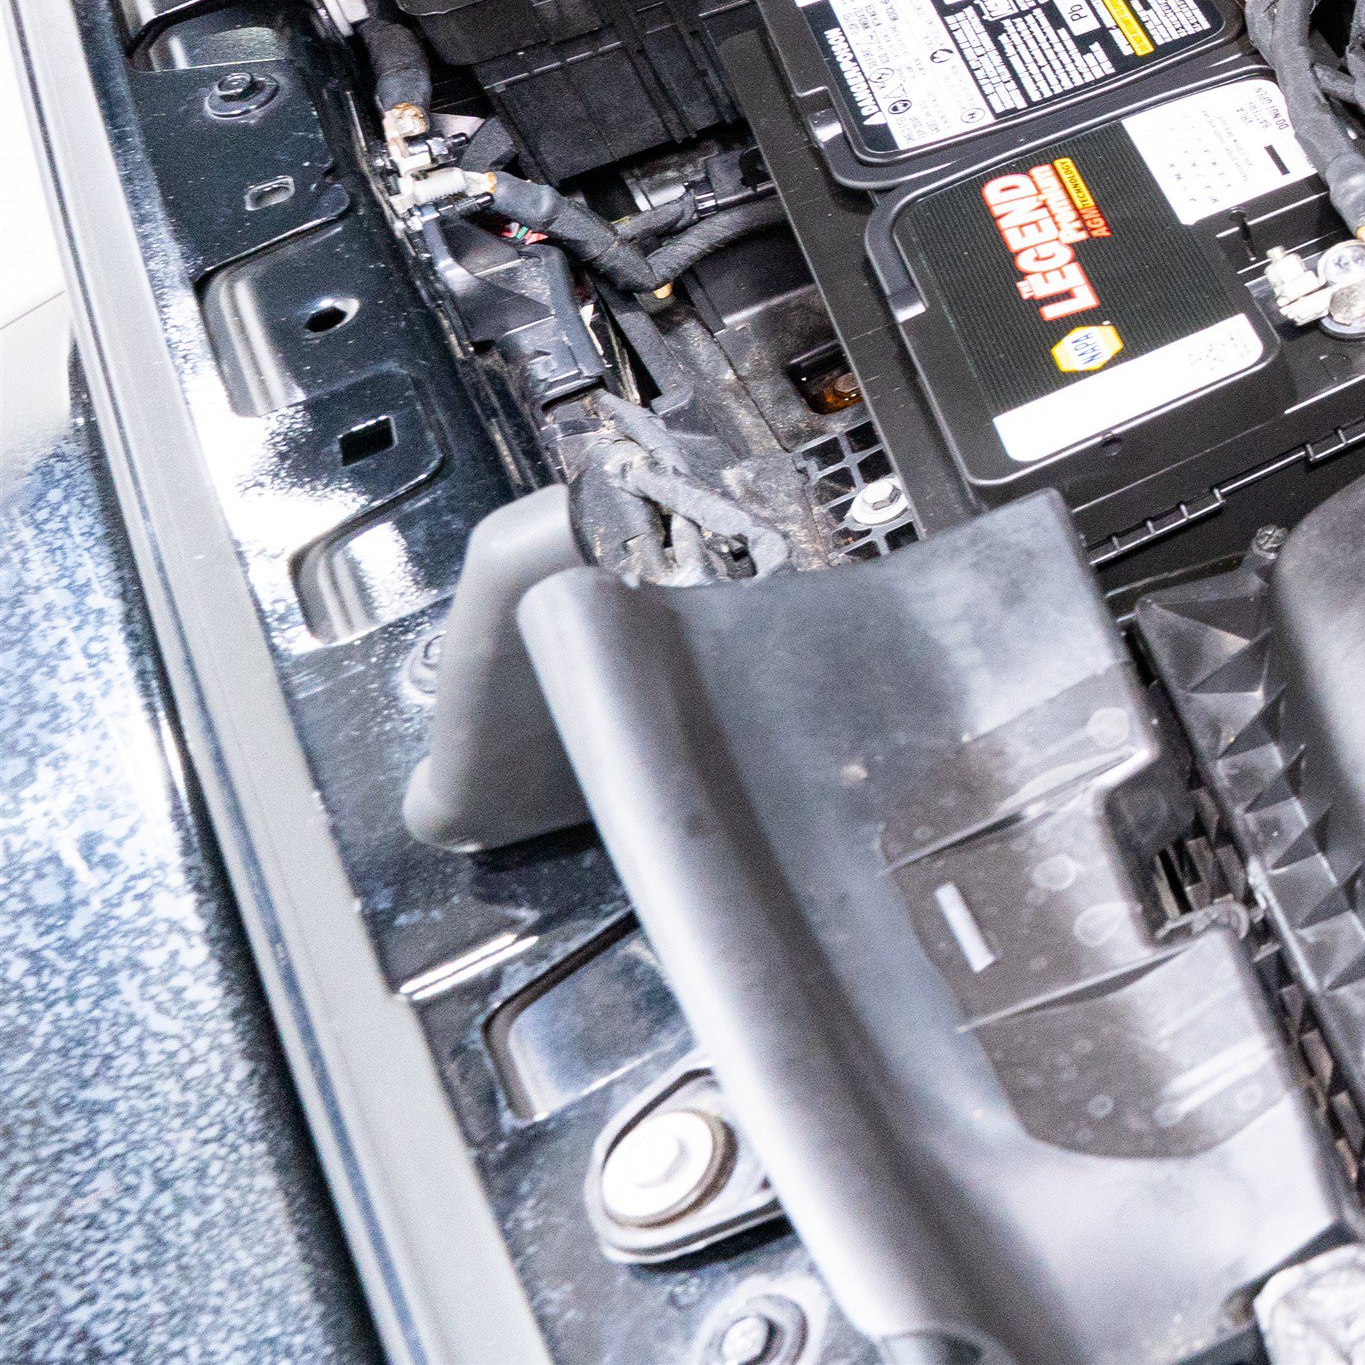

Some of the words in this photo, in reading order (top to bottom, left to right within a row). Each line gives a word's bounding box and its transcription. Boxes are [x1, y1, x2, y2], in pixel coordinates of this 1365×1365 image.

[1066, 3, 1089, 23] Pb
[1119, 16, 1138, 34] ATTEMPT
[1131, 34, 1144, 44] NOT
[1137, 43, 1149, 52] DO
[1254, 85, 1274, 104] OPEN
[1246, 99, 1271, 128] BATTERY
[1266, 104, 1282, 118] NOT
[1275, 118, 1289, 129] DO
[1056, 159, 1095, 208] TECHNOLOGY
[1029, 163, 1091, 242] Premium
[1082, 205, 1111, 238] AGM
[982, 172, 1100, 321] LEGEND
[1076, 331, 1105, 365] NAPA
